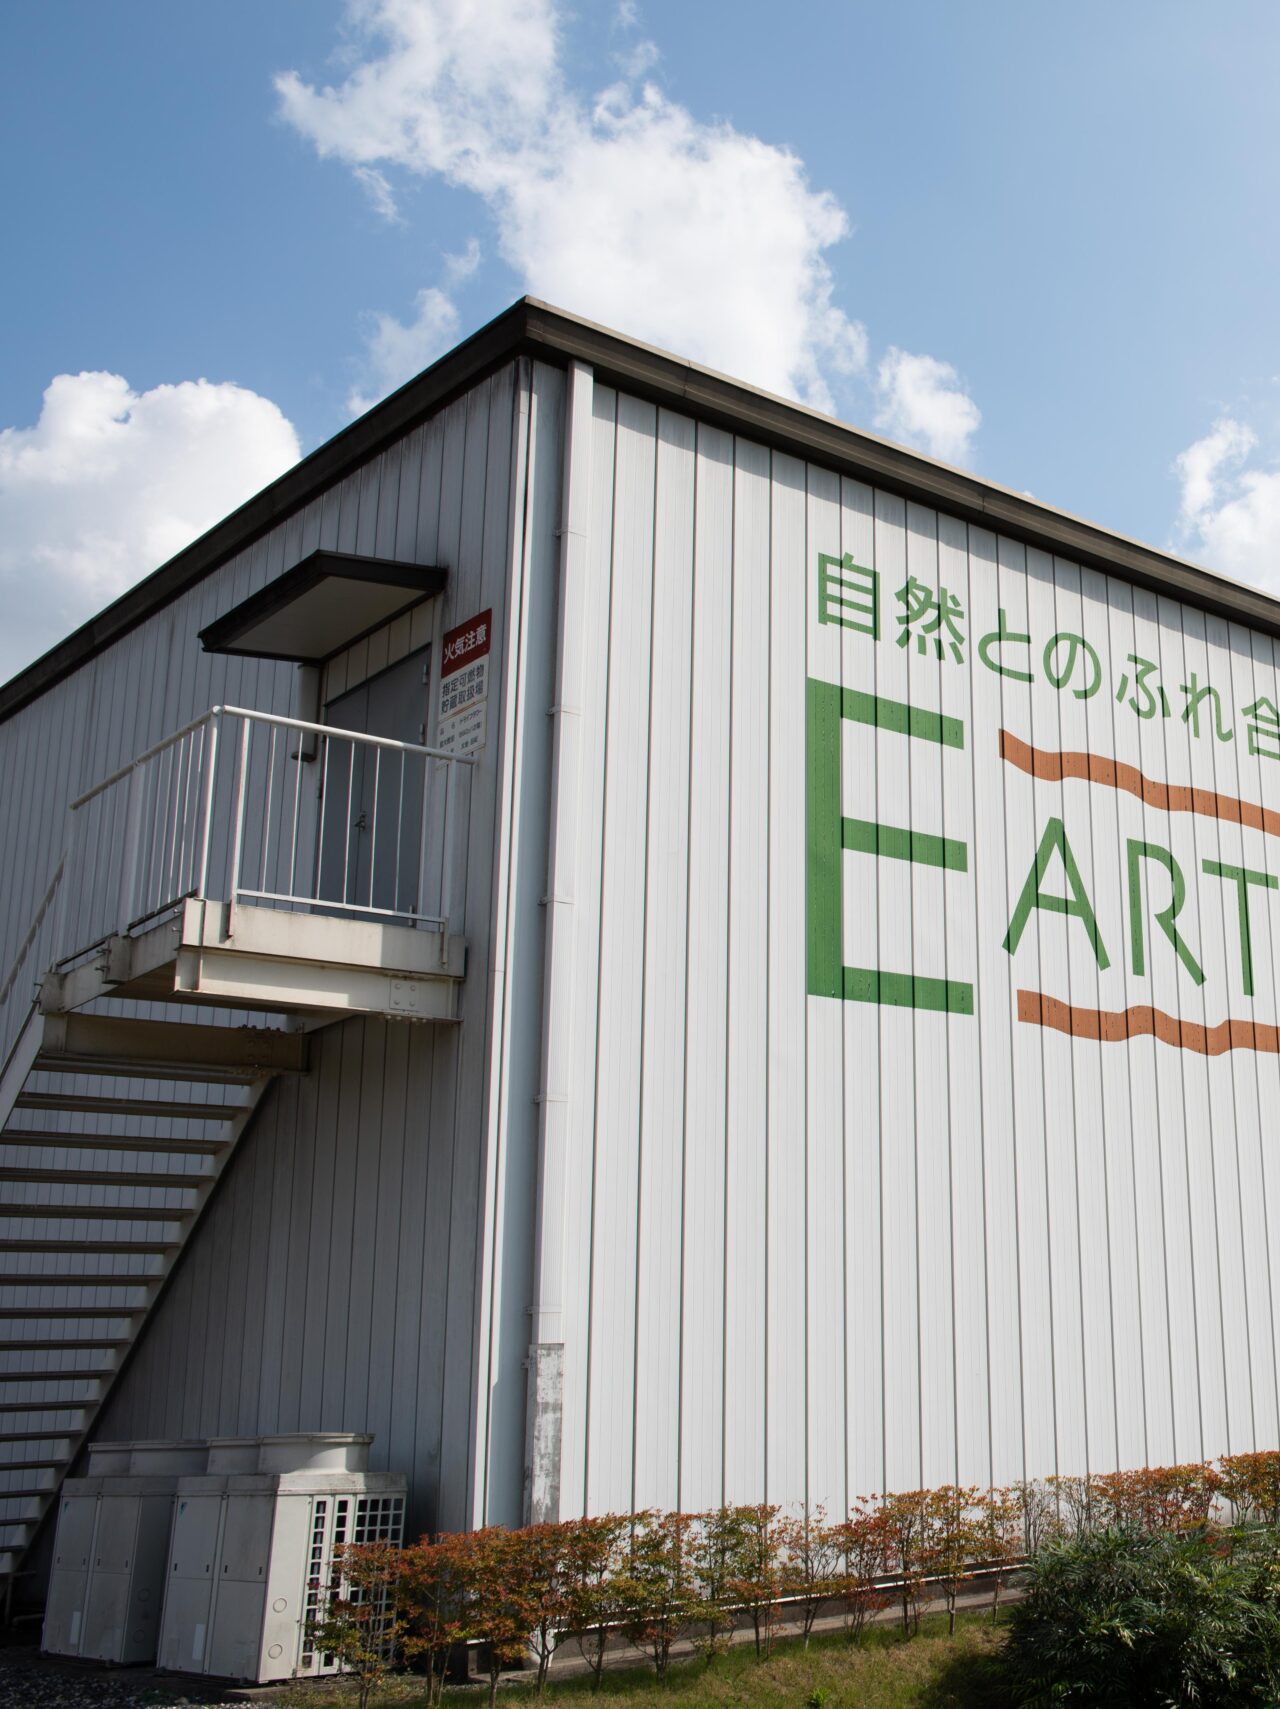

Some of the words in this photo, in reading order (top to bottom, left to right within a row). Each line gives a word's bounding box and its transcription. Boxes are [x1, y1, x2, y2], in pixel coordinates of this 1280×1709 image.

[444, 624, 487, 664] 火気注意
[442, 664, 485, 698] 指定可燃物
